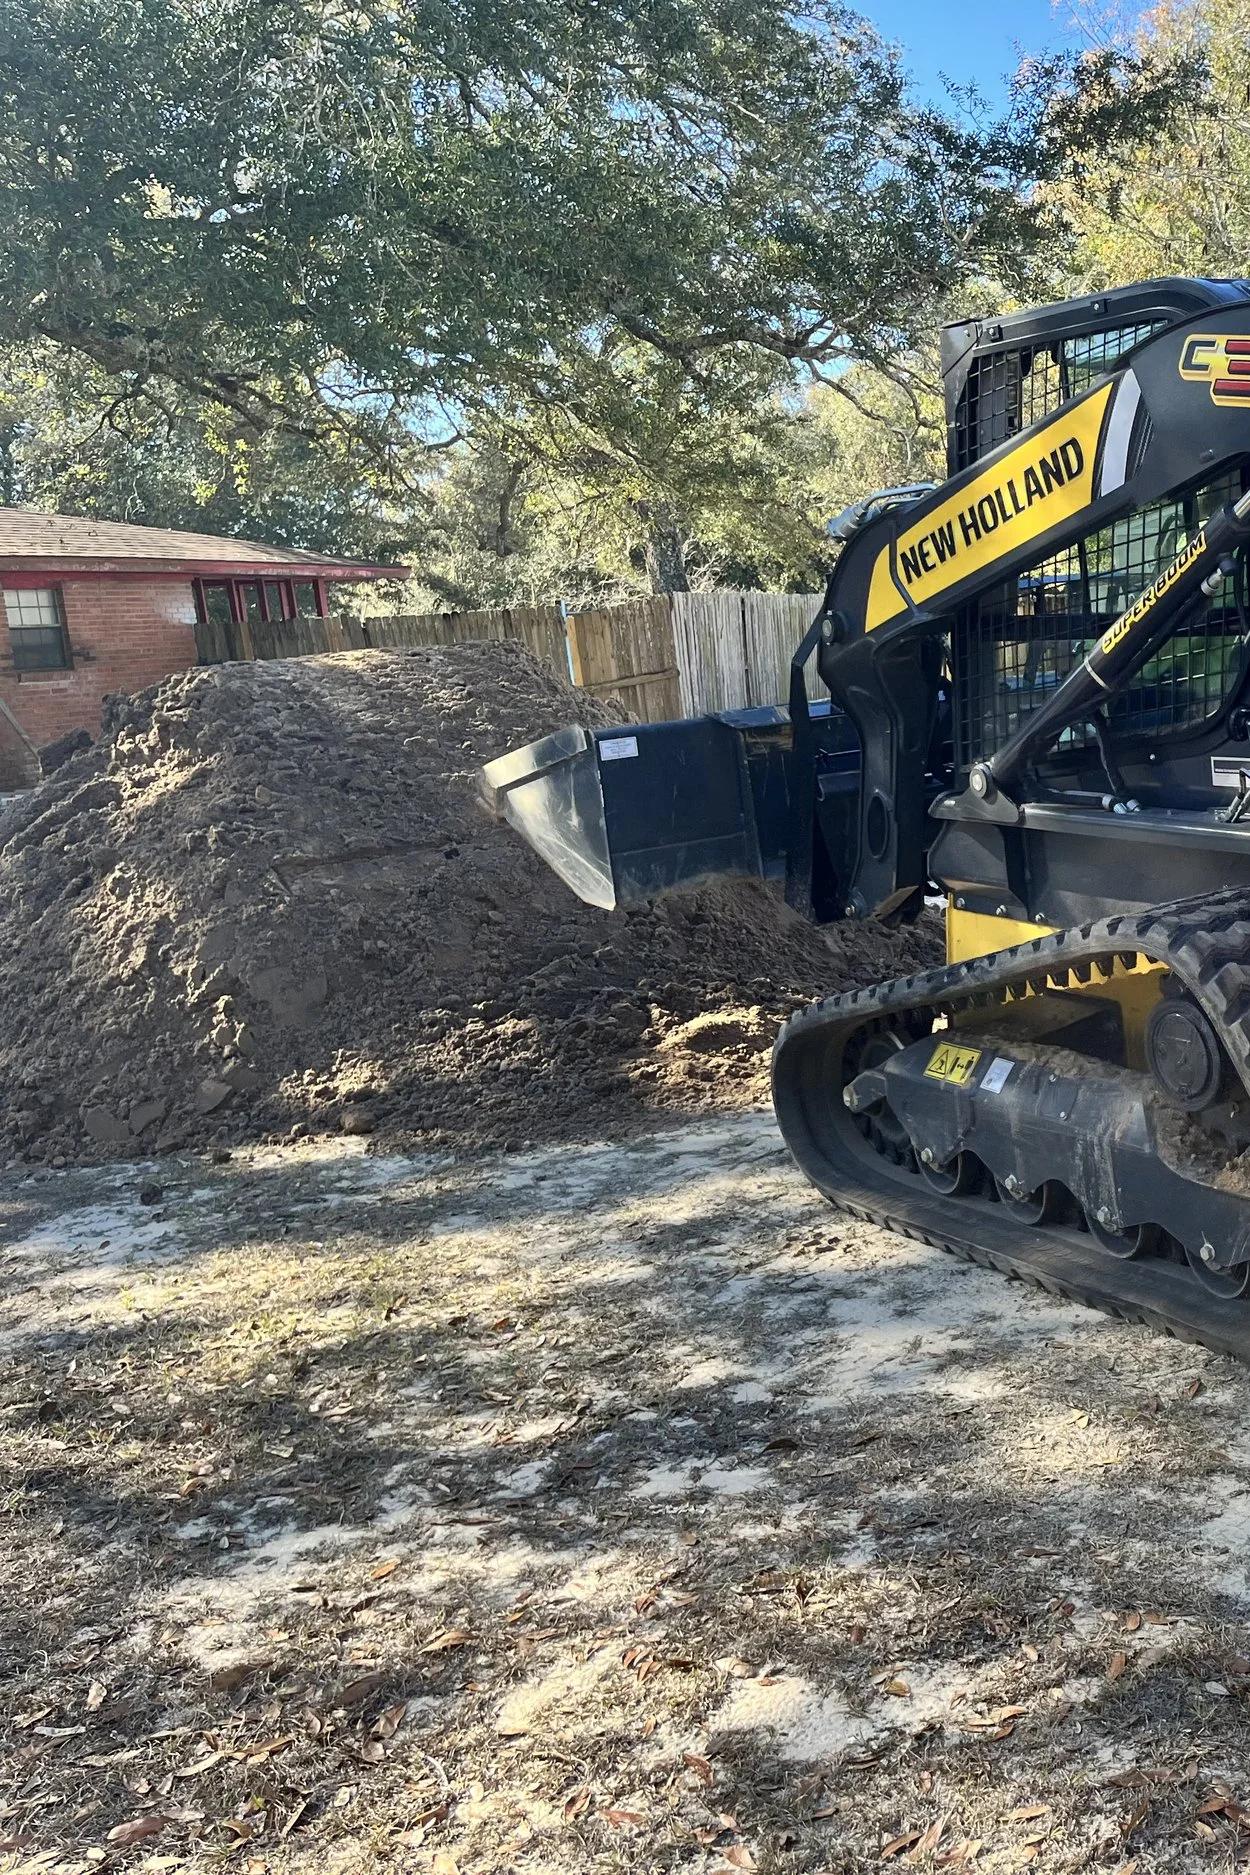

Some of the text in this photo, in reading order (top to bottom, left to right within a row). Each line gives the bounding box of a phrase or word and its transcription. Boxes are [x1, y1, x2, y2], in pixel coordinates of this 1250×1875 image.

[900, 436, 1085, 585] NEW HOLLAND
[1102, 530, 1207, 654] SUPER BOOM
